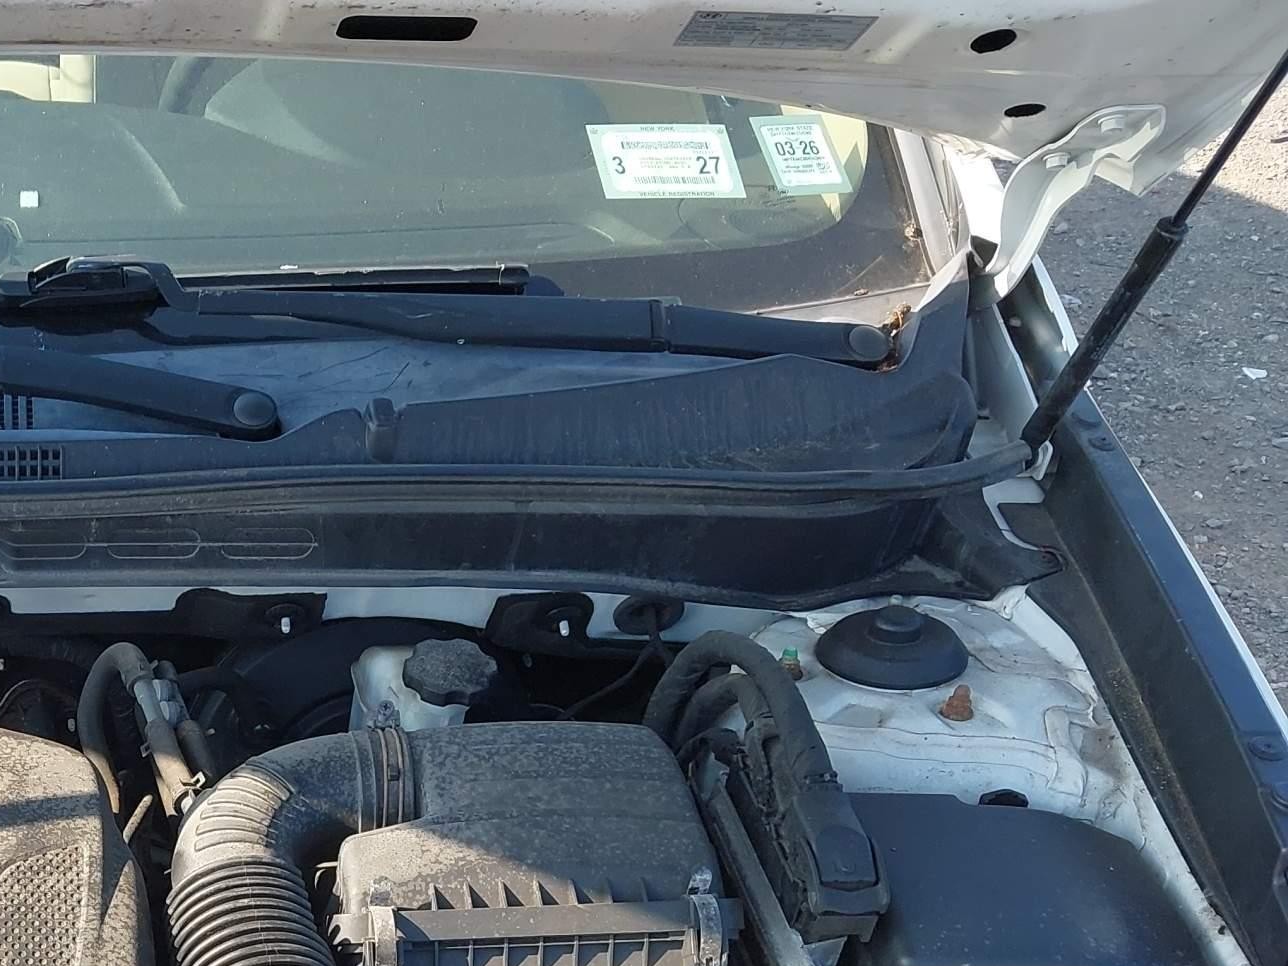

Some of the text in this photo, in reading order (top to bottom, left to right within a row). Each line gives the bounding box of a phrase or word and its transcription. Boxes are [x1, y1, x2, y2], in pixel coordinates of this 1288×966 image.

[774, 139, 820, 156] 03 26
[612, 156, 626, 175] 3
[696, 156, 721, 175] 27
